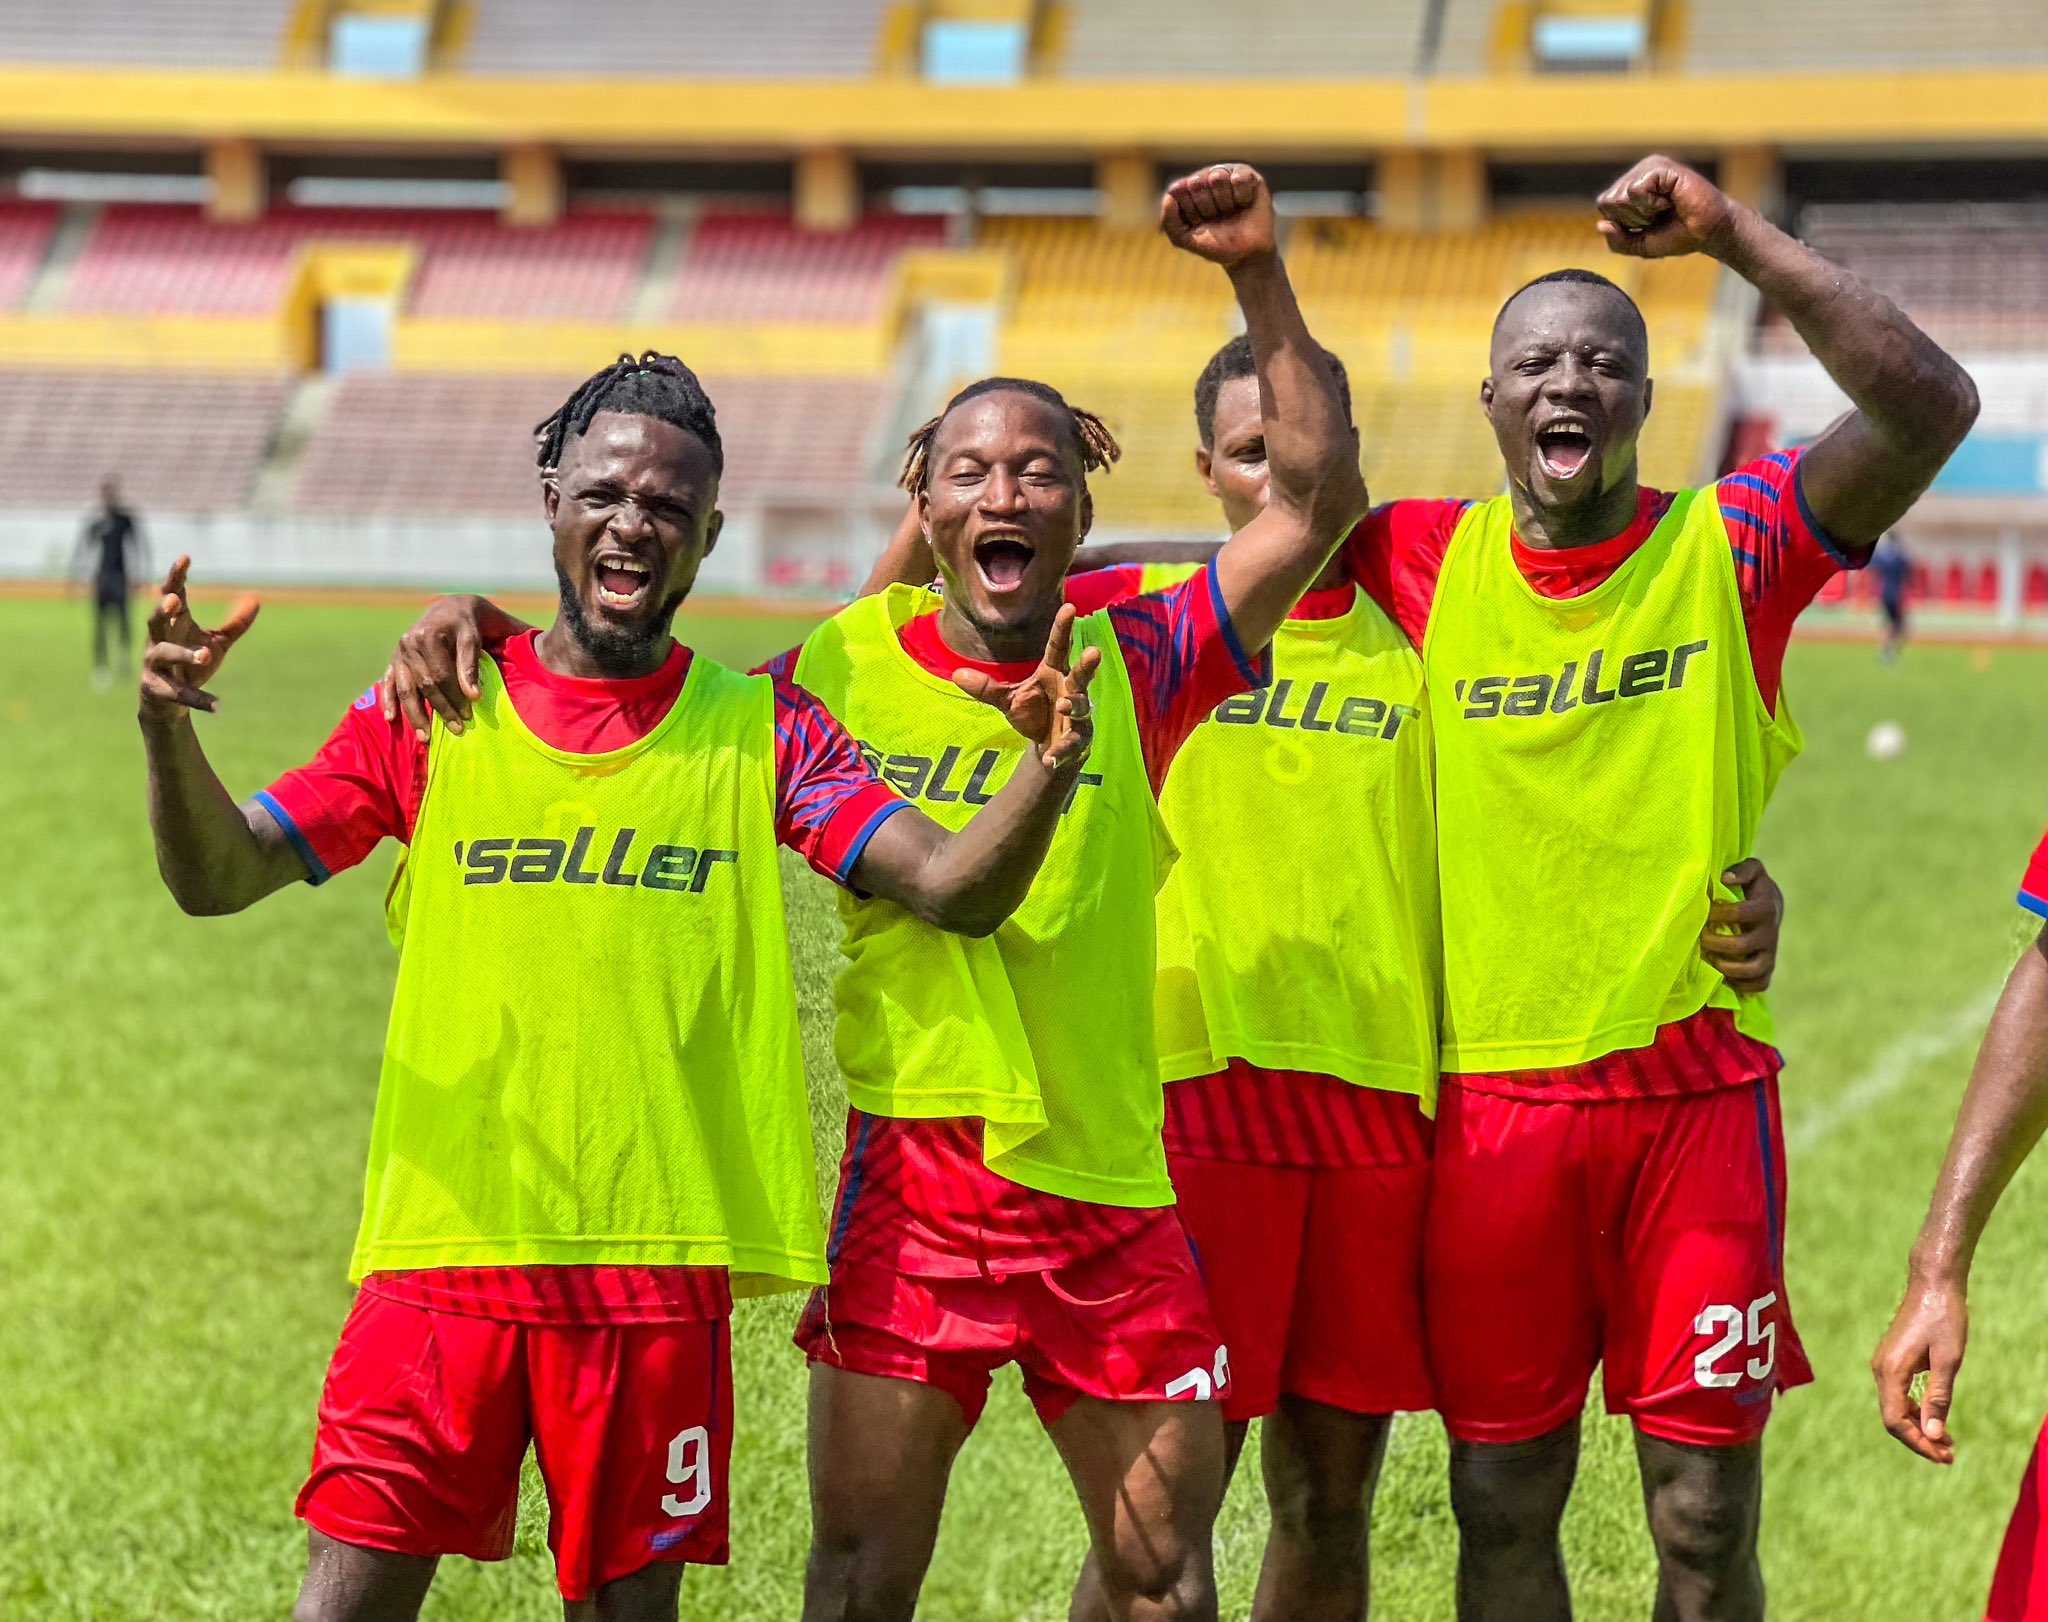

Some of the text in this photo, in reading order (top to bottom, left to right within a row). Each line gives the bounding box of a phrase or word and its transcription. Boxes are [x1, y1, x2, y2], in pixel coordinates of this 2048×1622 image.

[1200, 679, 1420, 740] aller
[1694, 1291, 1777, 1387] 25
[661, 1425, 711, 1517] 9
